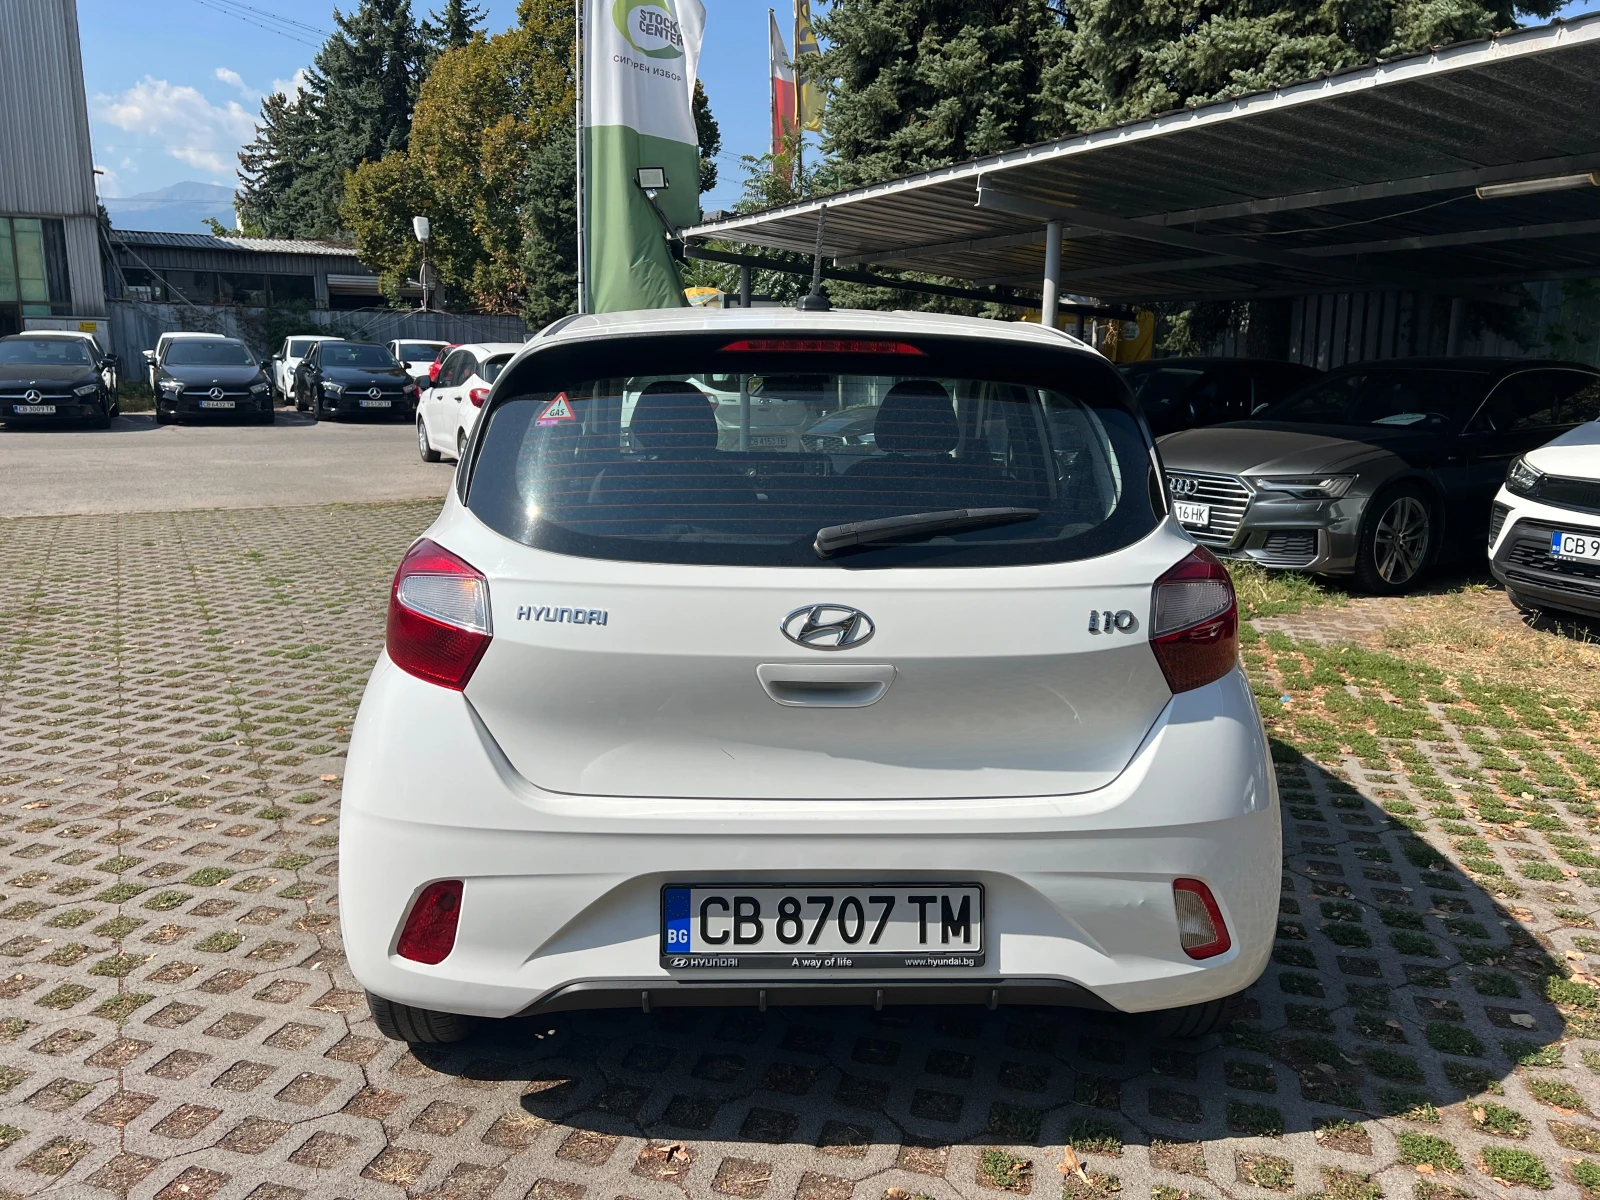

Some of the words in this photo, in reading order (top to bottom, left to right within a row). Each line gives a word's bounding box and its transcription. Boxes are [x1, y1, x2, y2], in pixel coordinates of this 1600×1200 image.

[640, 9, 679, 34] STOCK
[639, 20, 684, 47] CENTER
[653, 68, 681, 82] ИЗБОР
[549, 409, 565, 417] GAS
[1191, 507, 1206, 521] HK
[1563, 536, 1586, 555] CB
[516, 605, 609, 626] HYUNDAI
[699, 896, 764, 945] CB
[775, 895, 896, 945] 8707
[907, 895, 972, 945] TM
[667, 929, 688, 944] BG
[690, 958, 739, 967] HYUNDAI
[792, 957, 800, 967] A
[802, 958, 822, 968] way
[825, 957, 835, 967] of
[837, 957, 853, 967] life
[904, 957, 975, 968] www.hyundai.bg
